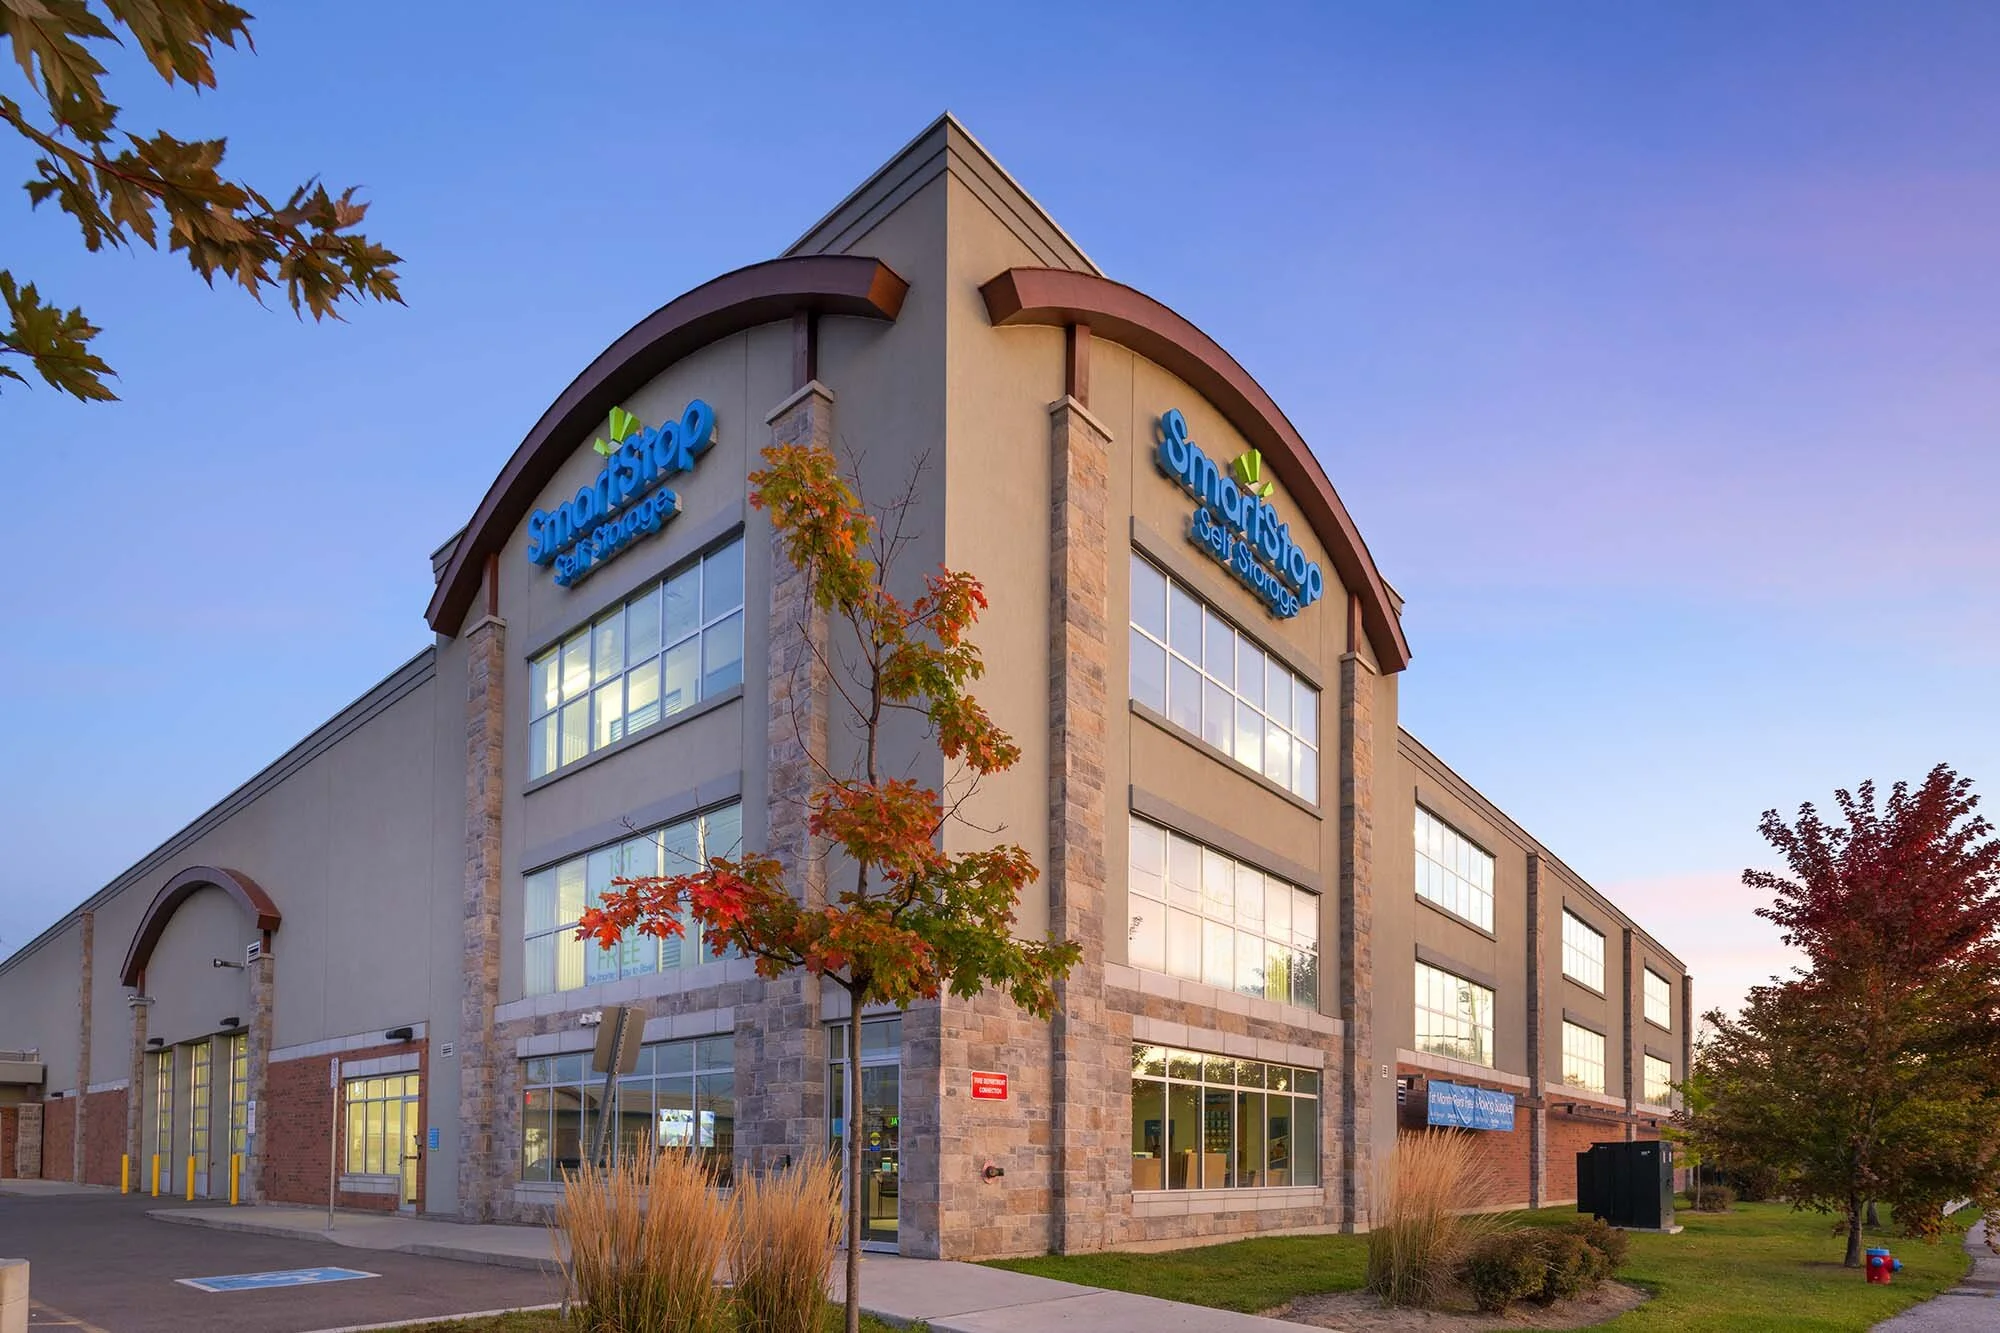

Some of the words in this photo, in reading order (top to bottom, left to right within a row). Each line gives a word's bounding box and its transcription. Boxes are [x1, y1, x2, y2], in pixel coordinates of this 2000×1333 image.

[528, 399, 716, 566] SmartStop
[554, 539, 592, 587] Self
[591, 487, 678, 560] Storage
[1159, 408, 1324, 608] SmartStop
[1191, 507, 1233, 561] Self
[1231, 540, 1299, 619] Storage
